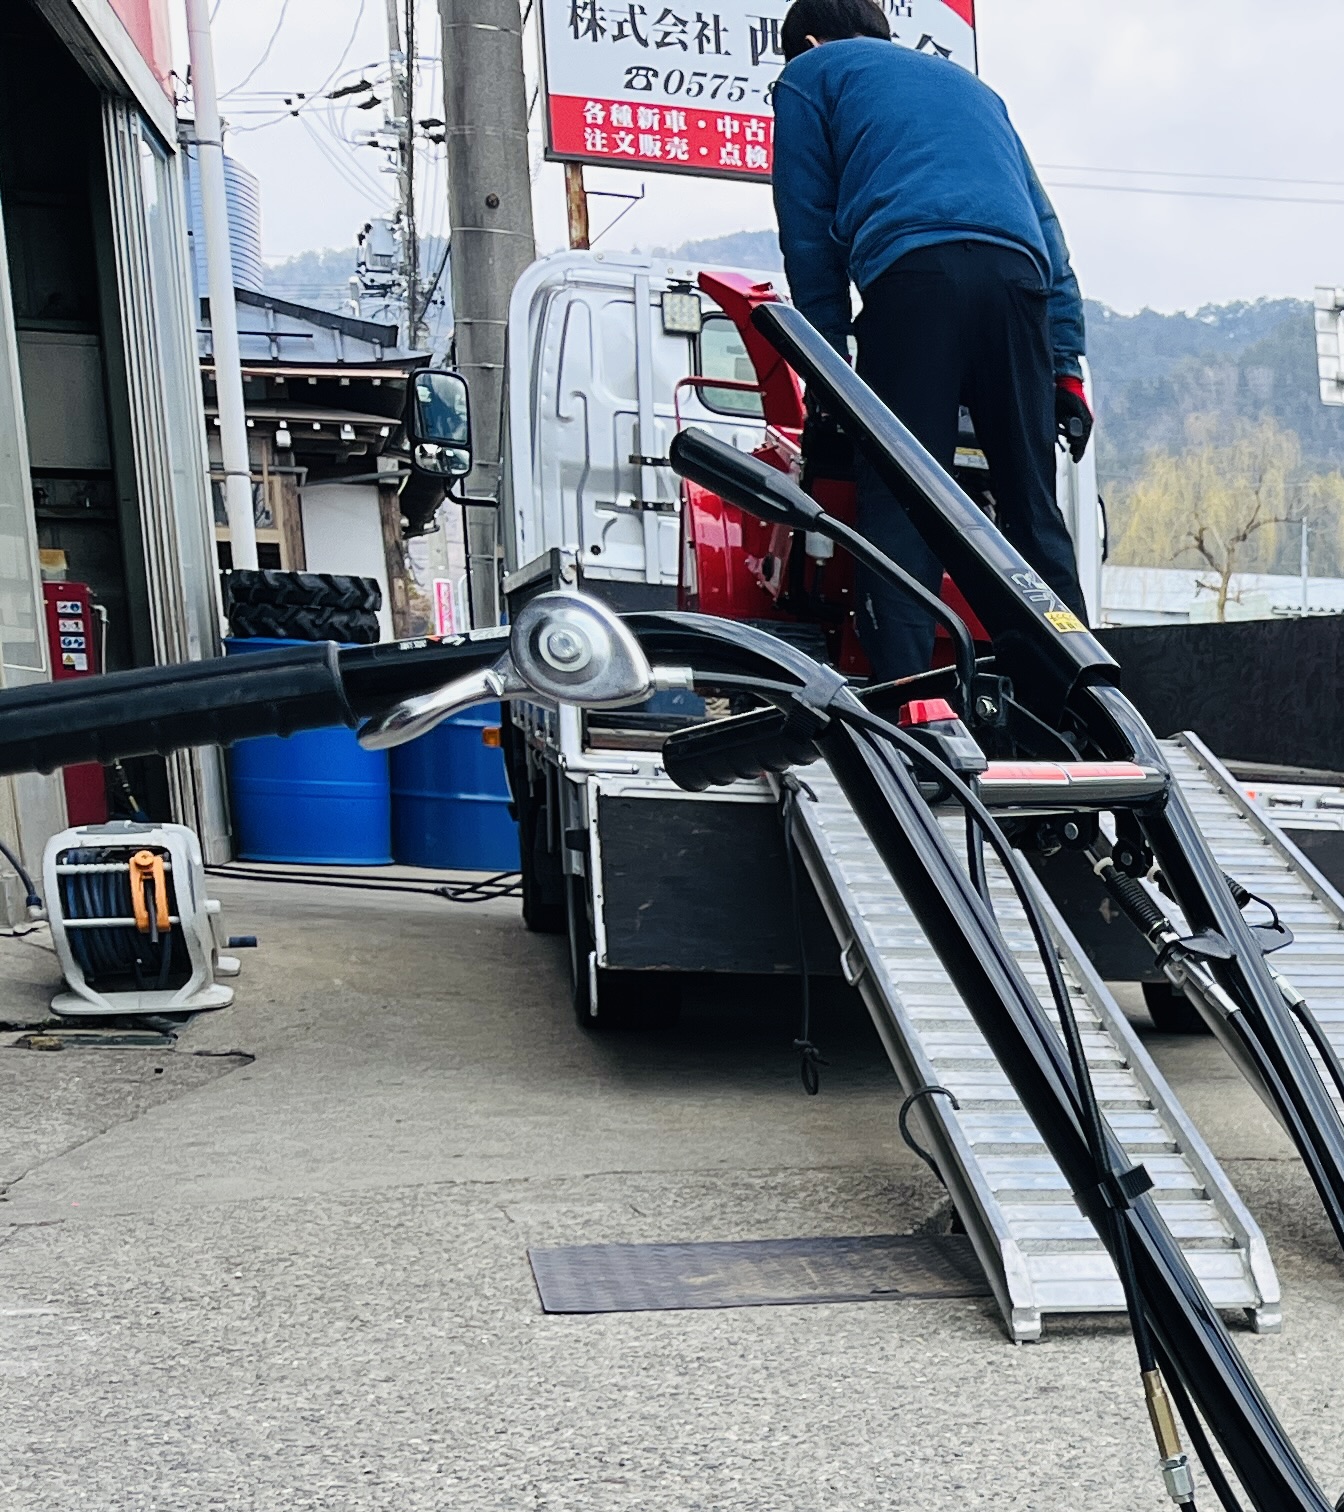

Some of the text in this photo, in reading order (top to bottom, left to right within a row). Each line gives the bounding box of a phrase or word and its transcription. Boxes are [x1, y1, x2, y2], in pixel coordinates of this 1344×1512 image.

[568, 0, 732, 56] 株式会社
[583, 100, 774, 144] 各種新車・中古
